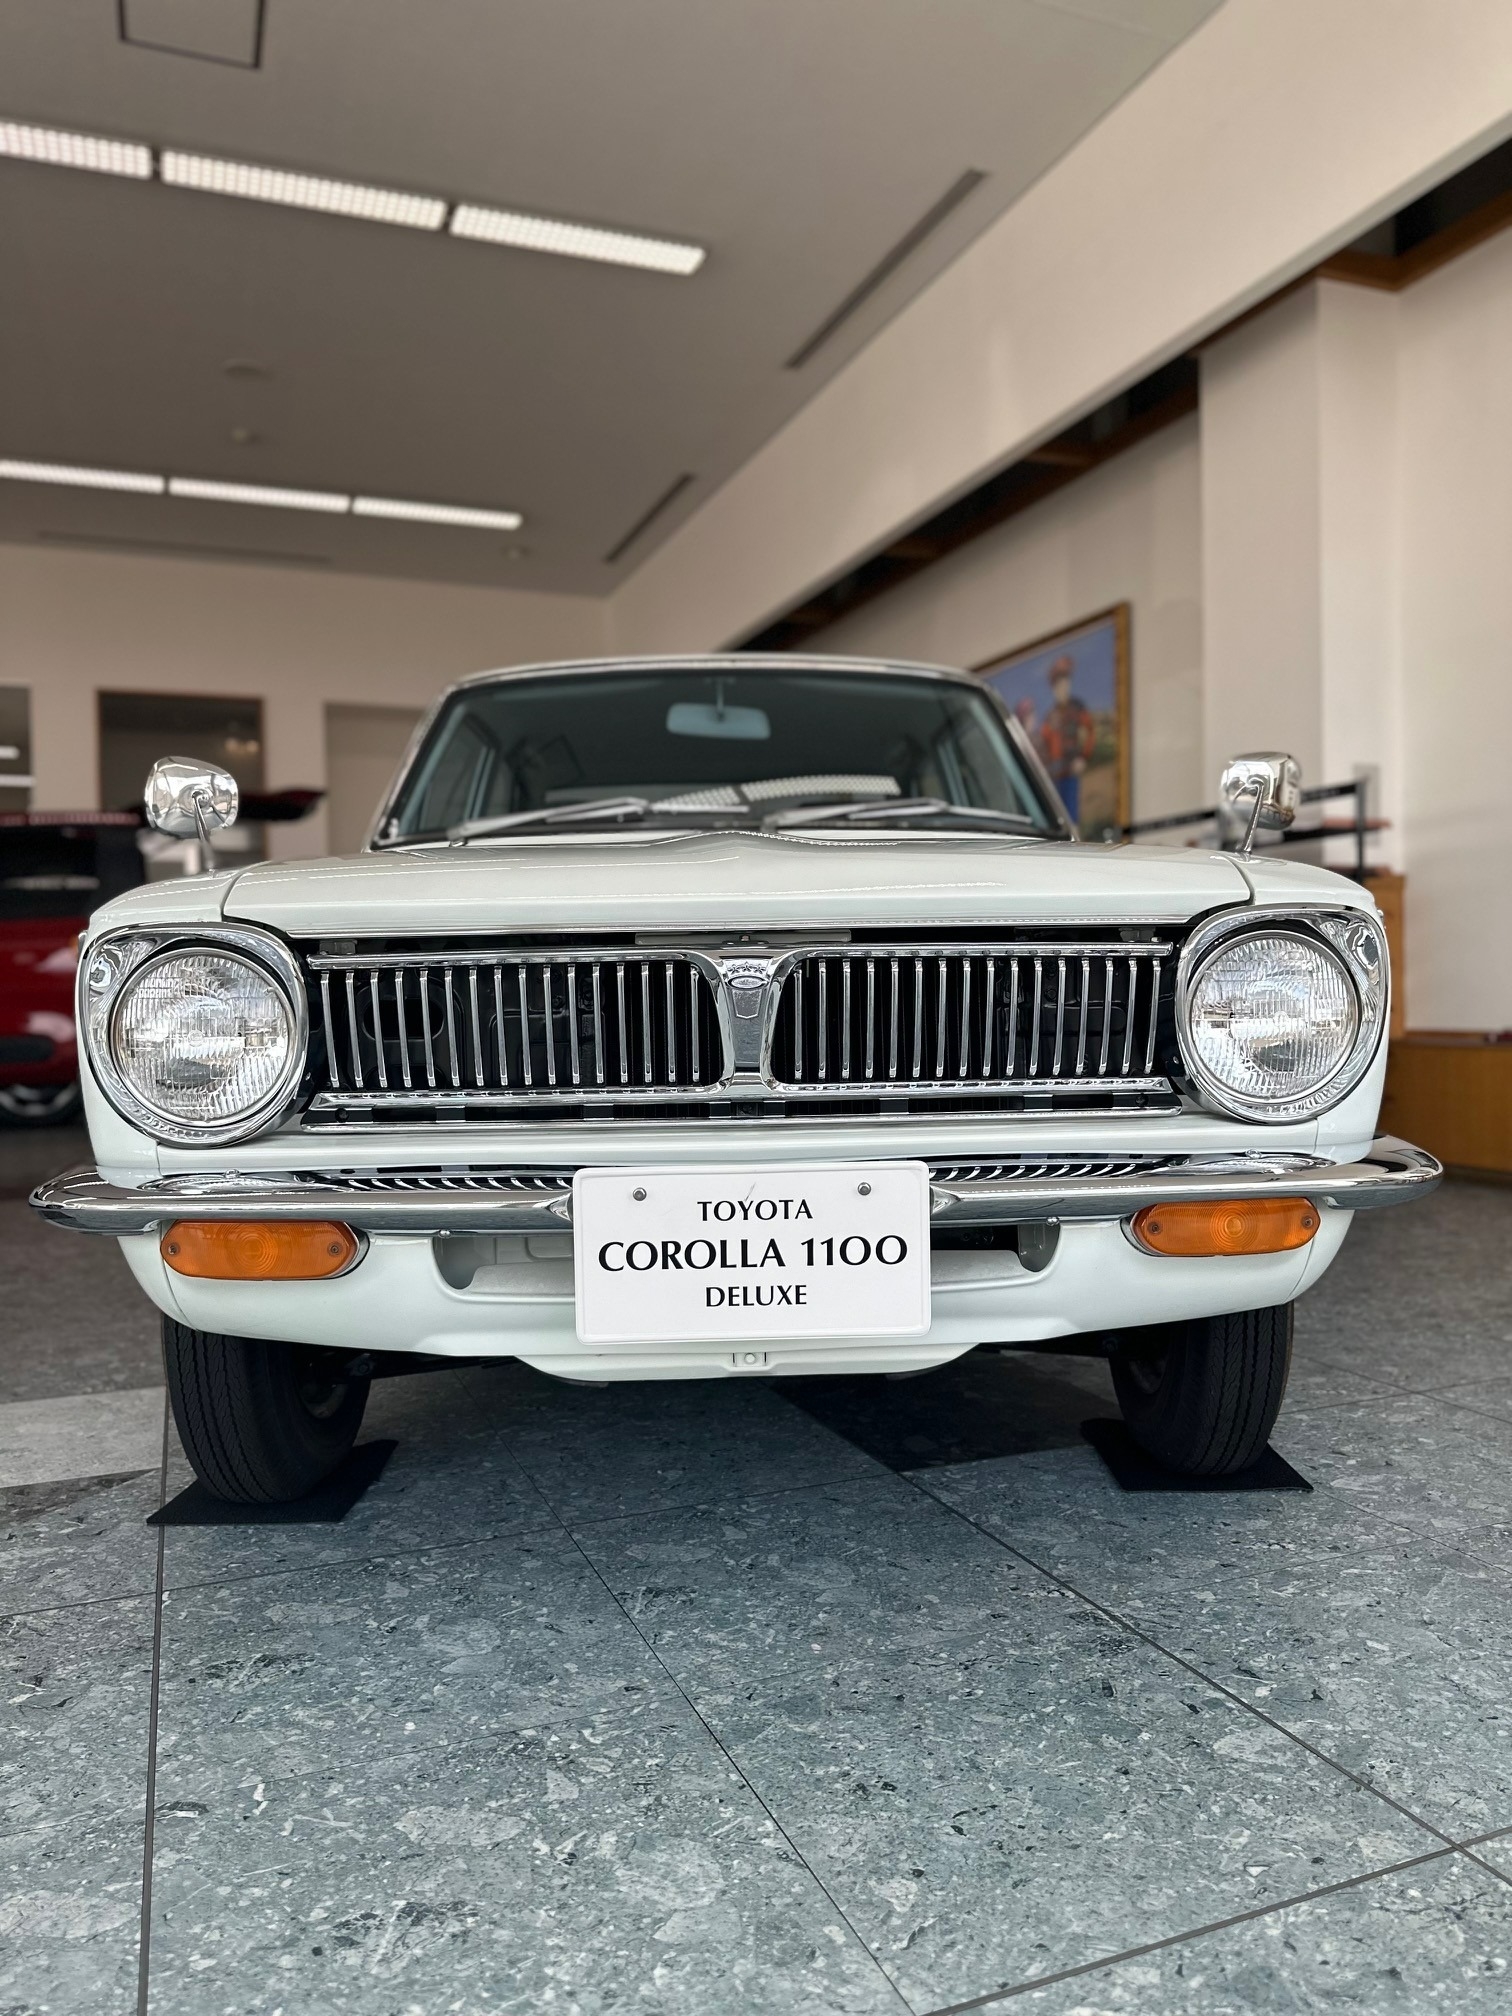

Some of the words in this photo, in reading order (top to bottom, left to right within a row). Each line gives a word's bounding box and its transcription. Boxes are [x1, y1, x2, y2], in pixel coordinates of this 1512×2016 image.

[697, 1199, 813, 1222] TOYOTA
[598, 1238, 787, 1272] COROLLA
[800, 1235, 909, 1267] 1100
[705, 1284, 808, 1307] DELUXE
